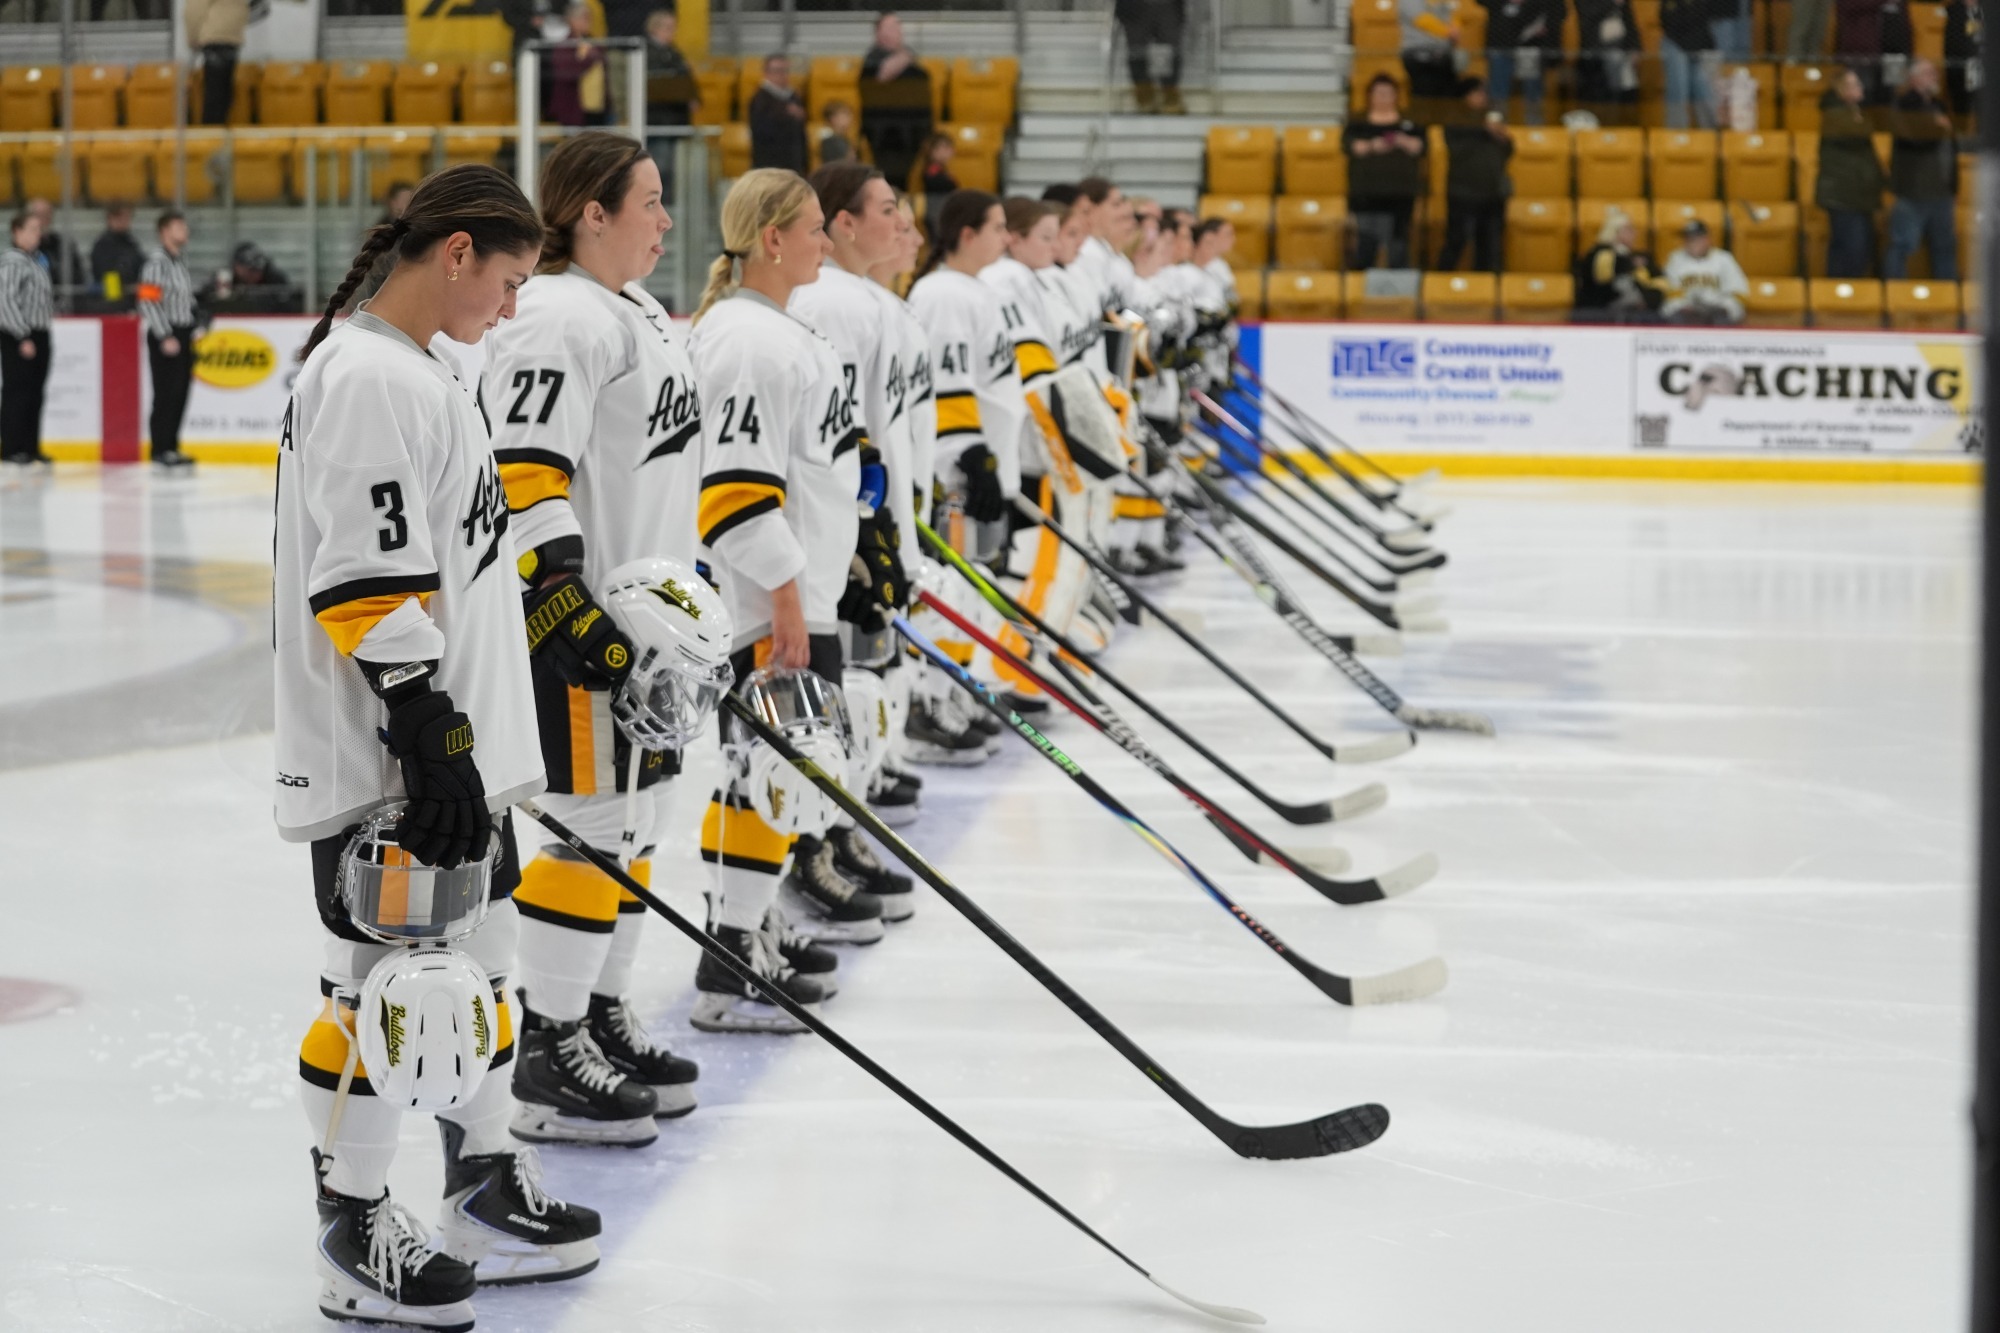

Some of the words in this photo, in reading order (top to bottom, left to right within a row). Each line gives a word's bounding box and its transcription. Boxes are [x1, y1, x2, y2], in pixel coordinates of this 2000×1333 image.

[1425, 339, 1553, 364] Community
[1425, 364, 1491, 382] Credit
[1498, 365, 1563, 382] Union
[506, 368, 566, 425] 27
[648, 371, 701, 438] Adr
[718, 395, 761, 444] 24
[370, 480, 408, 552] 3
[571, 608, 602, 638] Adrian
[388, 1004, 406, 1068] Bulldogs
[470, 994, 484, 1060] Bulldogs
[507, 1212, 550, 1233] BAUER
[354, 1261, 396, 1291] BAUR
